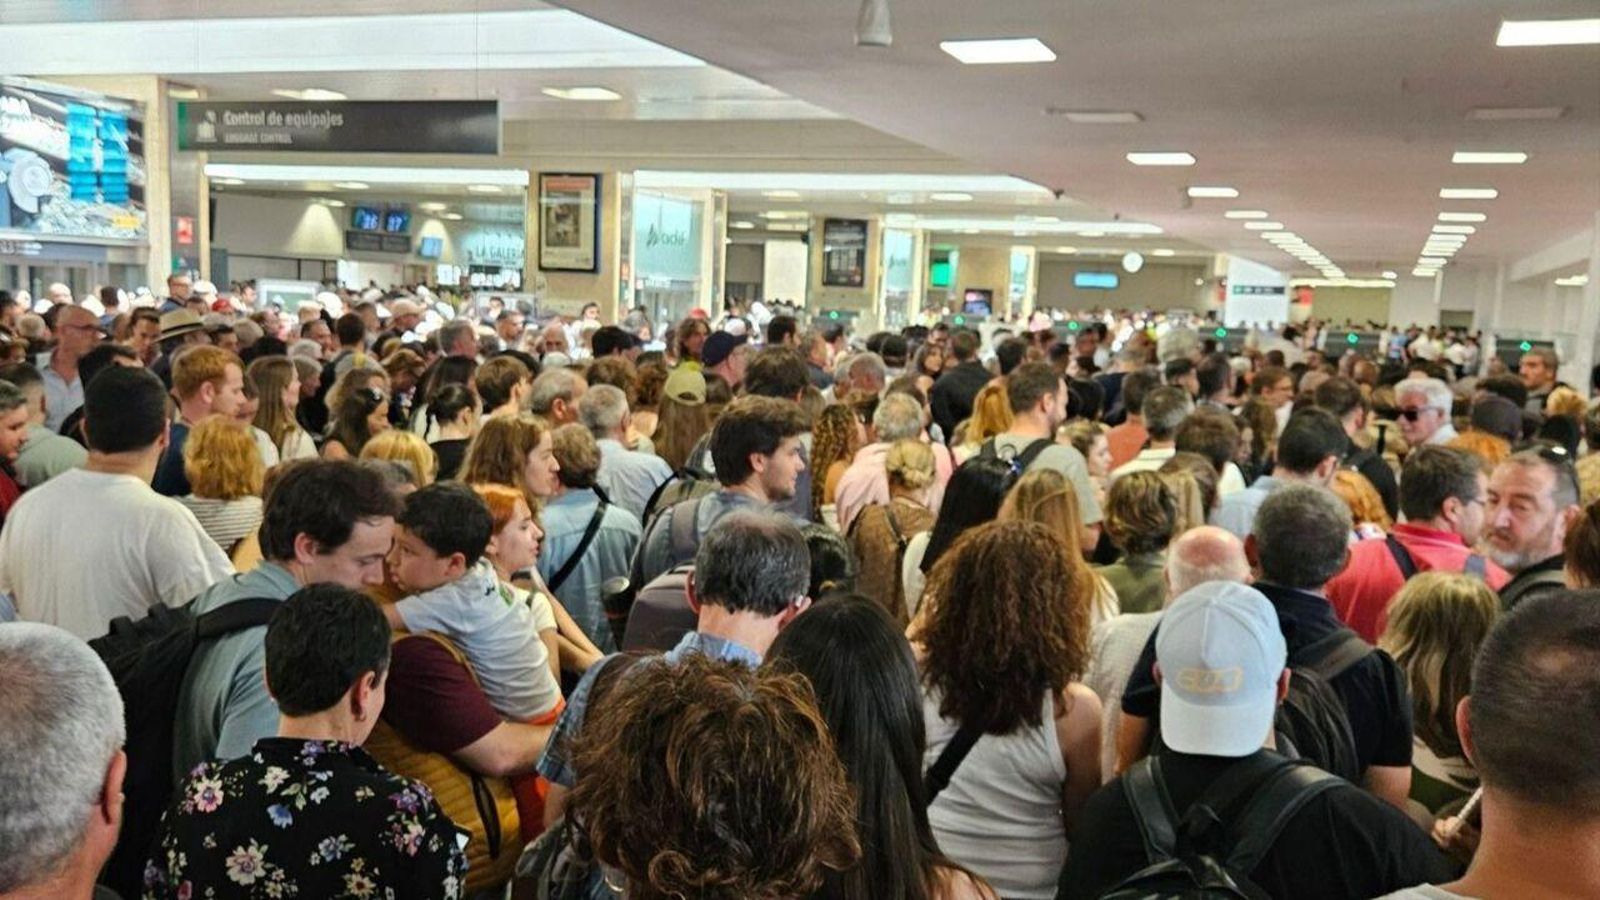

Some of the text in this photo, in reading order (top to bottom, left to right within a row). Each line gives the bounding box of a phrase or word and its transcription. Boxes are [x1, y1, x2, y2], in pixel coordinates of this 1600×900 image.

[224, 110, 343, 129] Control de equipajes
